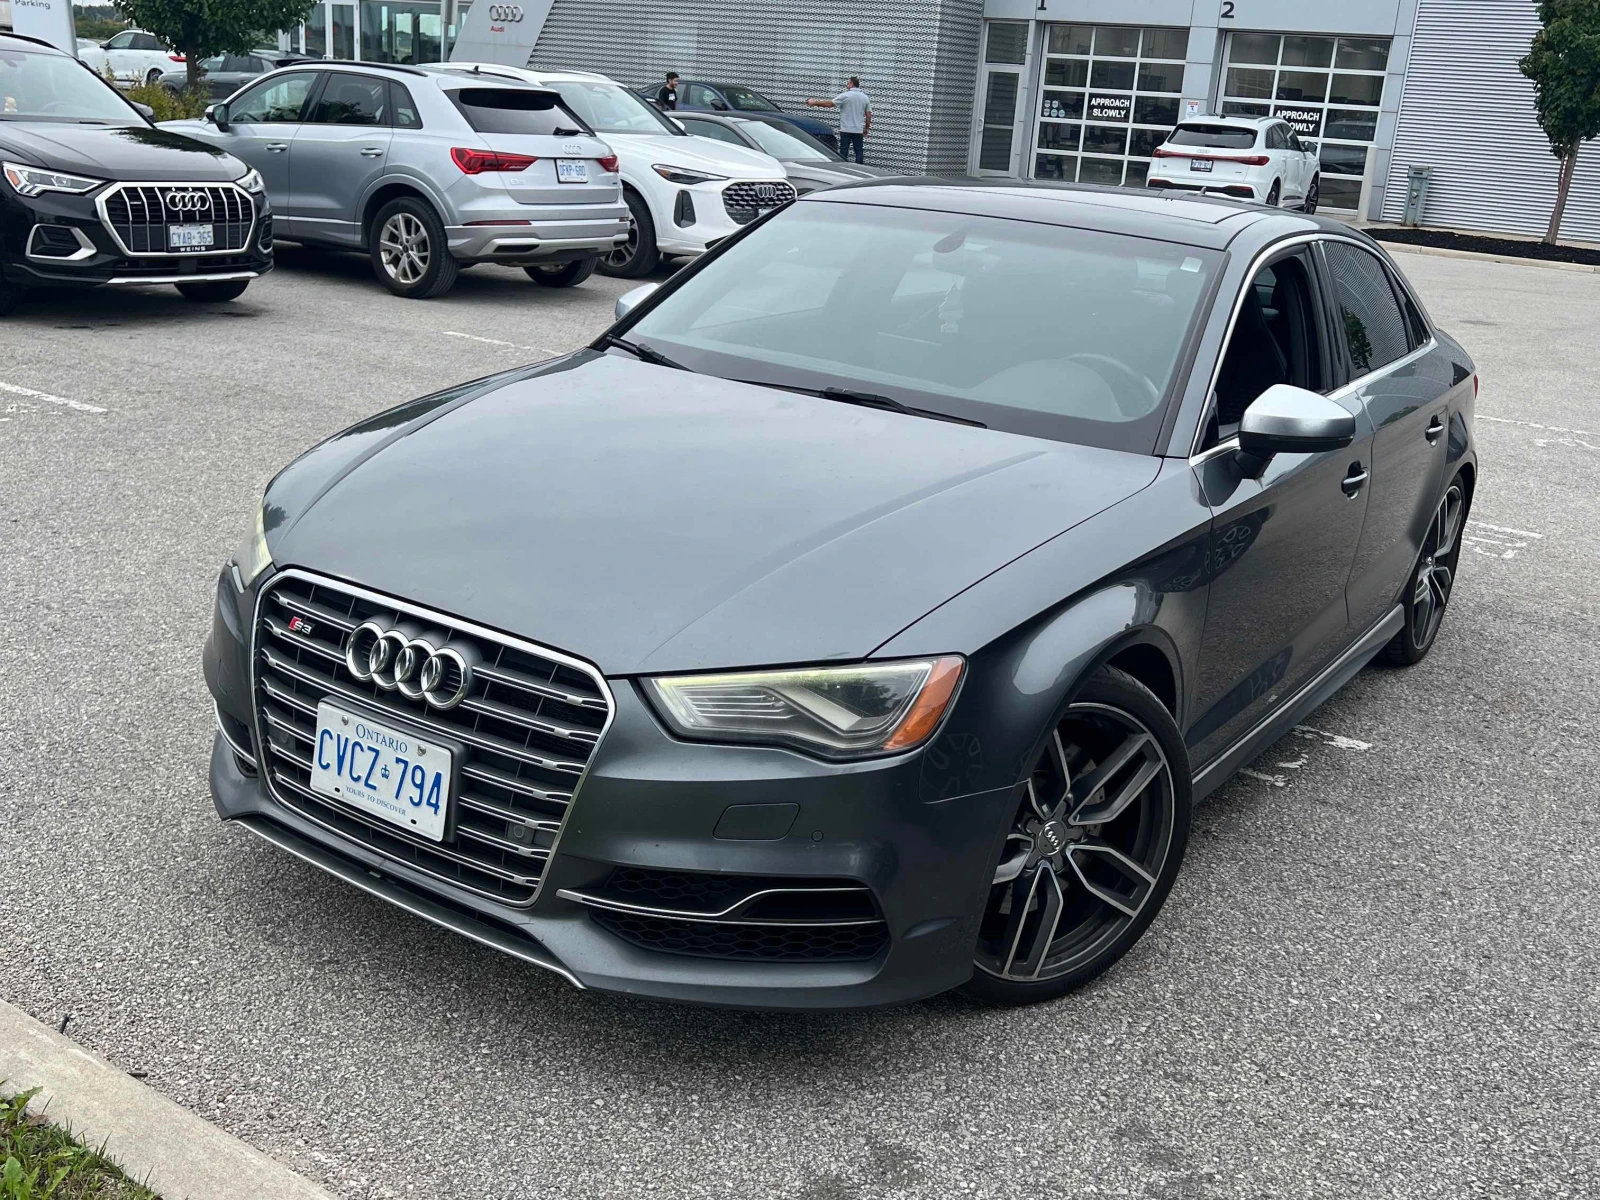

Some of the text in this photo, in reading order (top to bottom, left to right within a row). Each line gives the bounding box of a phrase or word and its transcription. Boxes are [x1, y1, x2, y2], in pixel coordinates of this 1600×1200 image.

[1221, 1, 1235, 19] 2
[1090, 97, 1130, 108] APPROACH
[1092, 108, 1127, 118] SLOWLY
[1275, 109, 1320, 121] APPROACH
[1288, 121, 1316, 132] OWLY
[293, 620, 312, 635] S3
[355, 723, 408, 753] ONTARIO
[345, 785, 407, 817] YOURS TO DISCOVER
